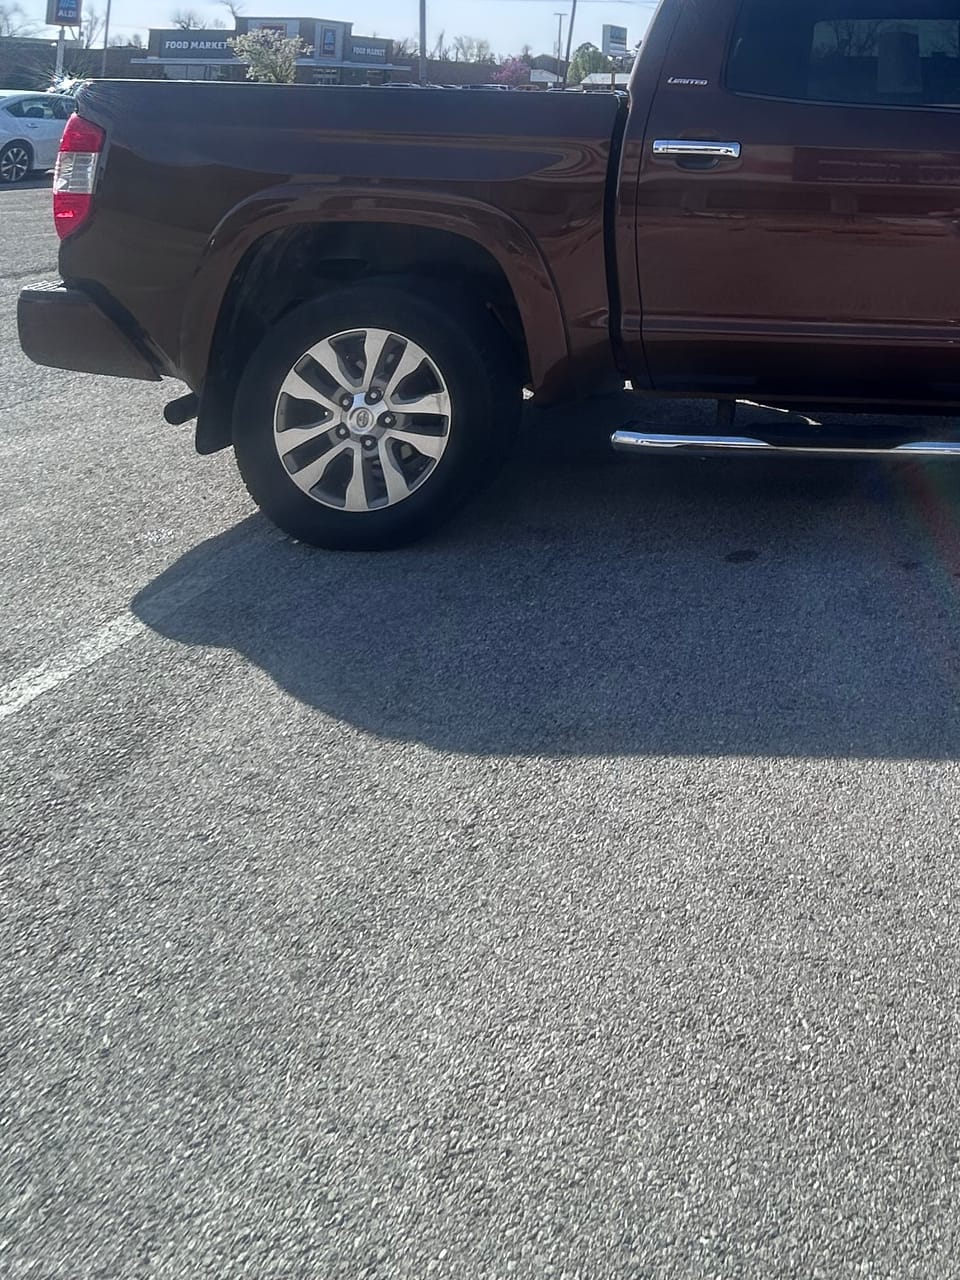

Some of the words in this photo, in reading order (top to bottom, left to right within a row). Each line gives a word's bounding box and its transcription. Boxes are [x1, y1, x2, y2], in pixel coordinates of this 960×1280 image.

[58, 10, 77, 18] ALDI
[165, 41, 188, 49] FOOD
[190, 41, 228, 50] MARKET
